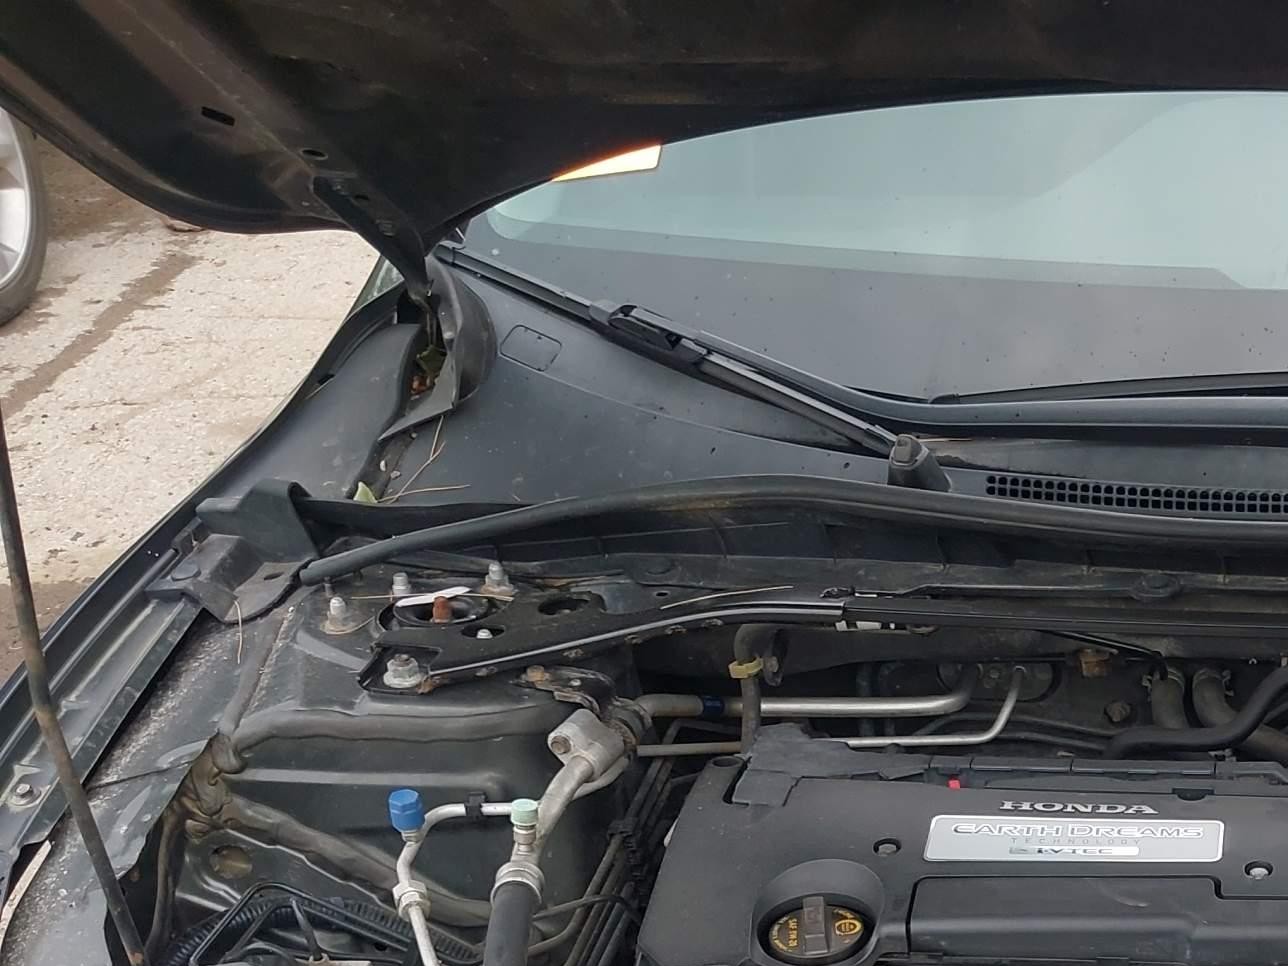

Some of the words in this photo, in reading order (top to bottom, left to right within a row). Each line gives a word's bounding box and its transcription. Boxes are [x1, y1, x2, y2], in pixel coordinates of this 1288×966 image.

[1000, 800, 1158, 815] HONDA
[953, 823, 1062, 837] EARTH
[1069, 823, 1204, 838] DREAMS
